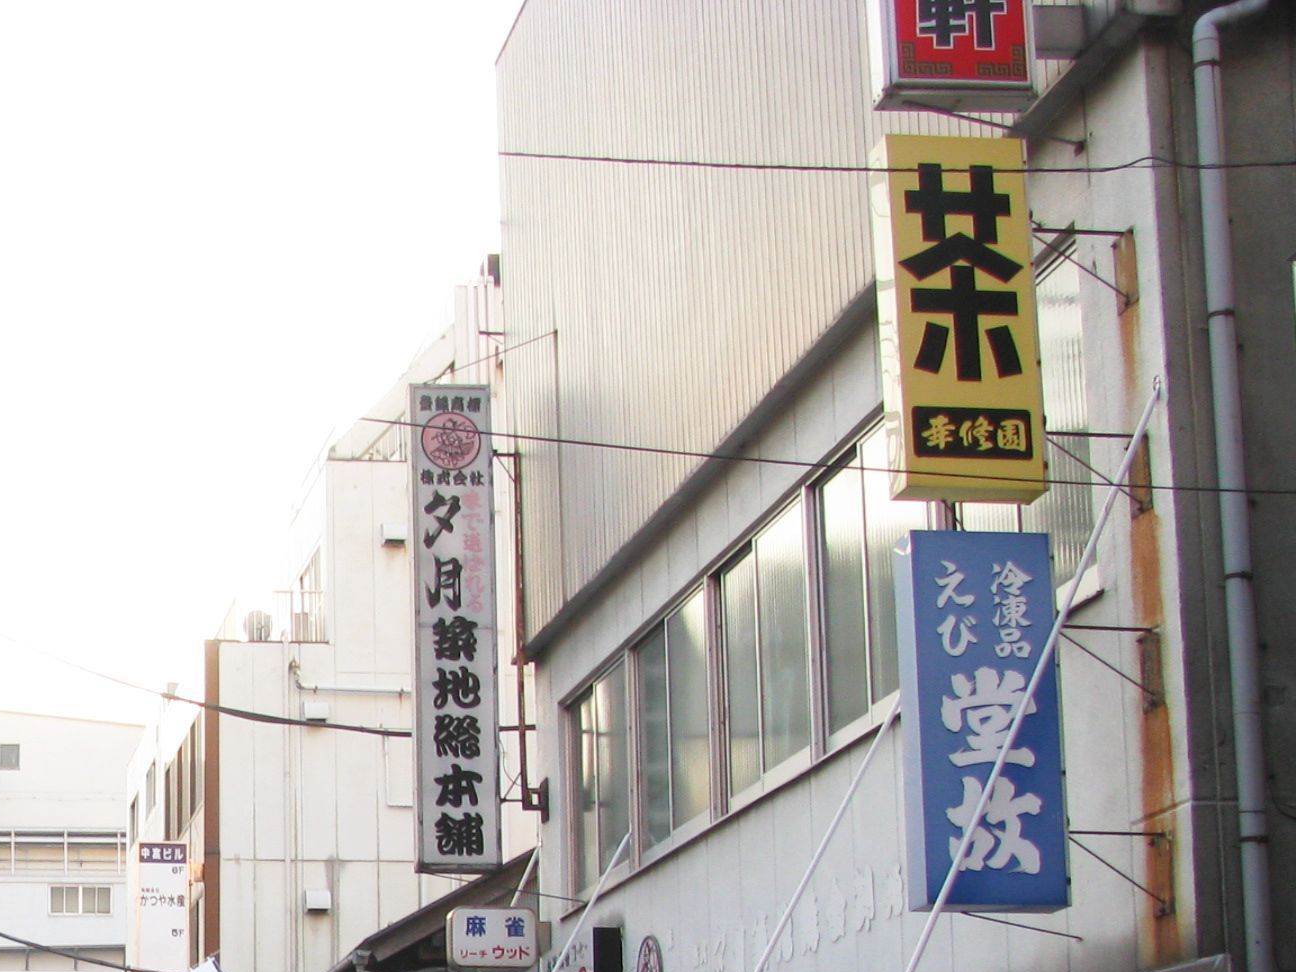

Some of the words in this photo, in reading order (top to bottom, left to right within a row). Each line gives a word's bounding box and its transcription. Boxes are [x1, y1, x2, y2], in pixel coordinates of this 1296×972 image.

[899, 163, 1025, 383] 茶
[420, 469, 485, 487] 株式会社
[935, 559, 978, 657] えび
[465, 915, 526, 939] 麻雀
[460, 947, 488, 960] リーチ
[491, 945, 531, 961] ウッド
